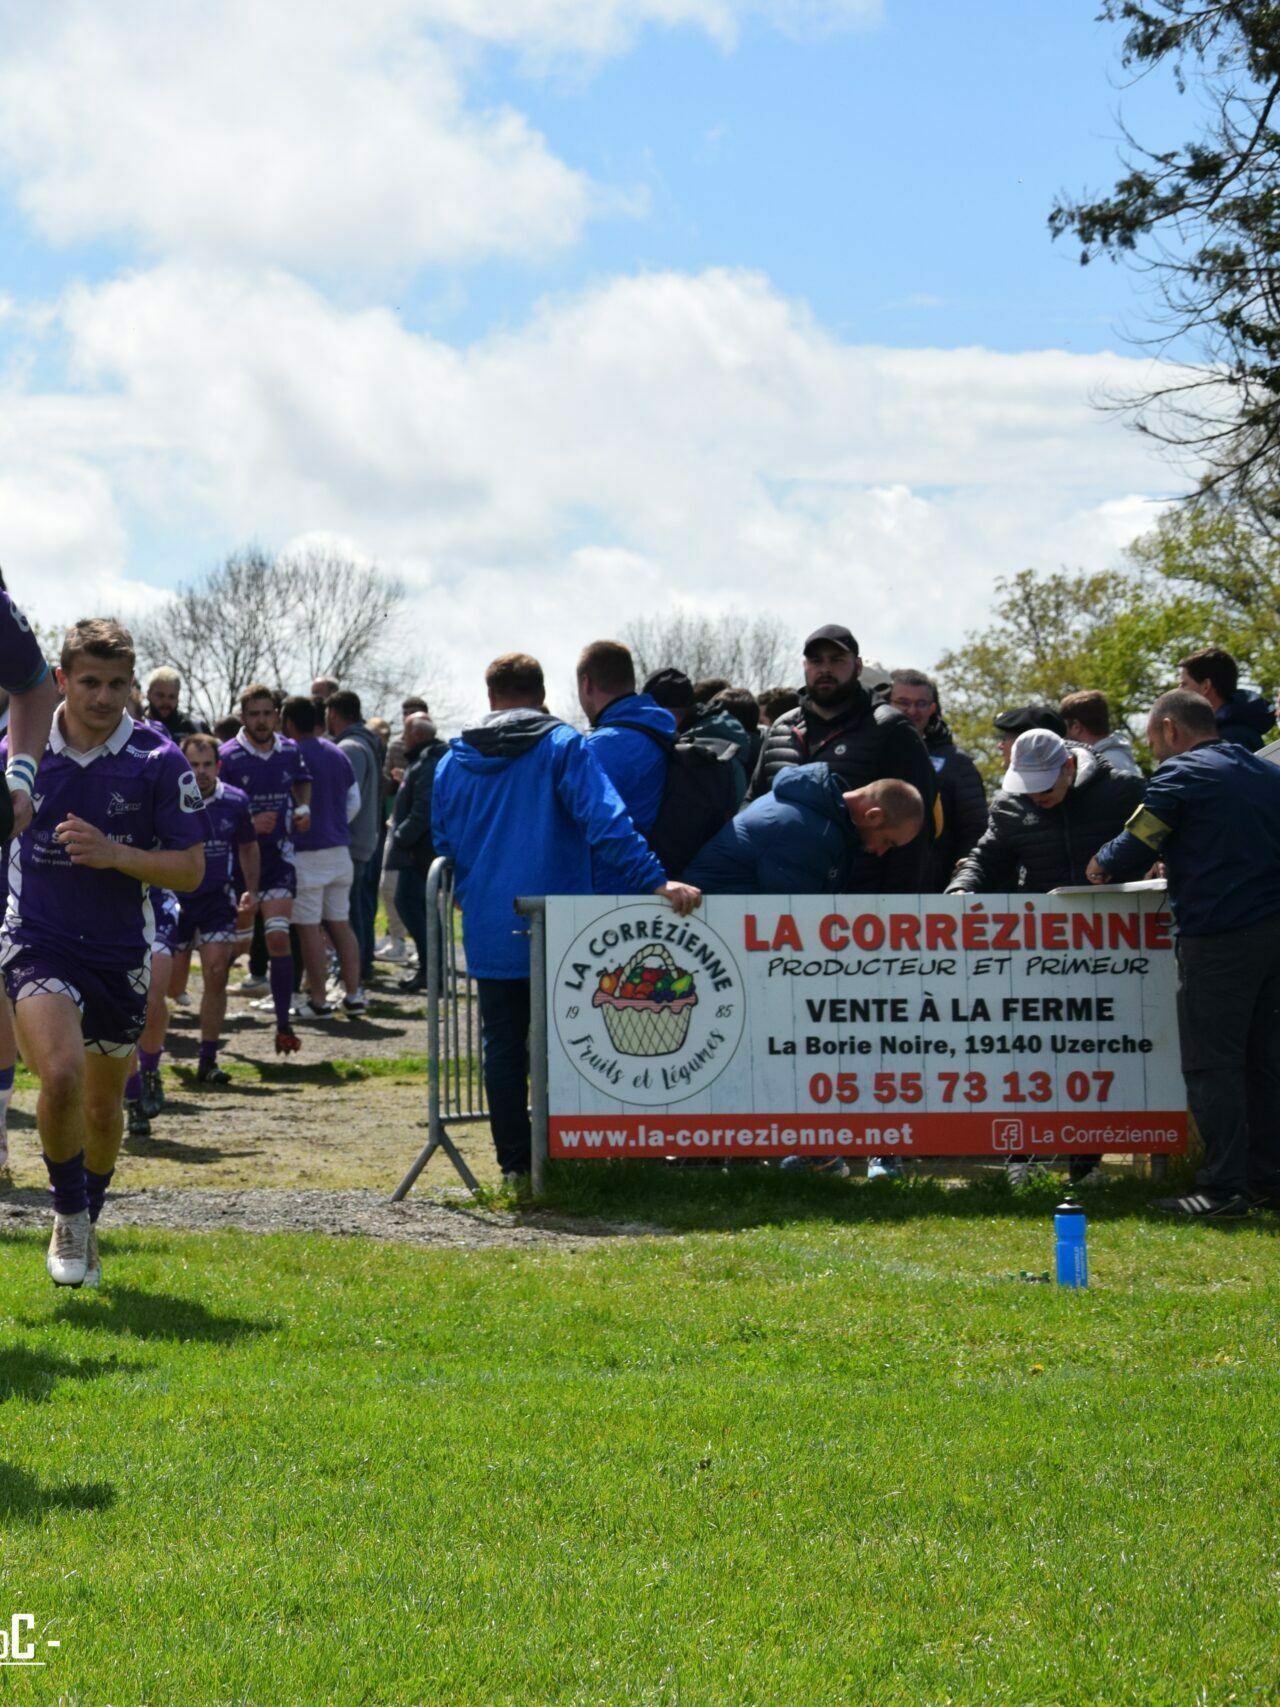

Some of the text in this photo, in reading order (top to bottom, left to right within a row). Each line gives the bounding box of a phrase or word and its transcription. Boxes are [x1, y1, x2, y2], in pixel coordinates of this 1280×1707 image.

[744, 913, 804, 951] LA
[565, 961, 592, 992] LA
[768, 956, 957, 977] PRODUCTEUR
[973, 956, 1012, 976] ET
[565, 1006, 580, 1020] 19
[715, 1004, 735, 1018] 85
[805, 990, 1115, 1023] VENTE À LA FERME
[768, 1034, 1153, 1058] La Borie Noire, 19140 Uzerche
[568, 1028, 726, 1090] Fruits et Légumes
[809, 1070, 1115, 1104] 05 55 73 13 07
[559, 1123, 913, 1147] www.la-correzienne.net
[1031, 1125, 1179, 1144] La Corrézienne
